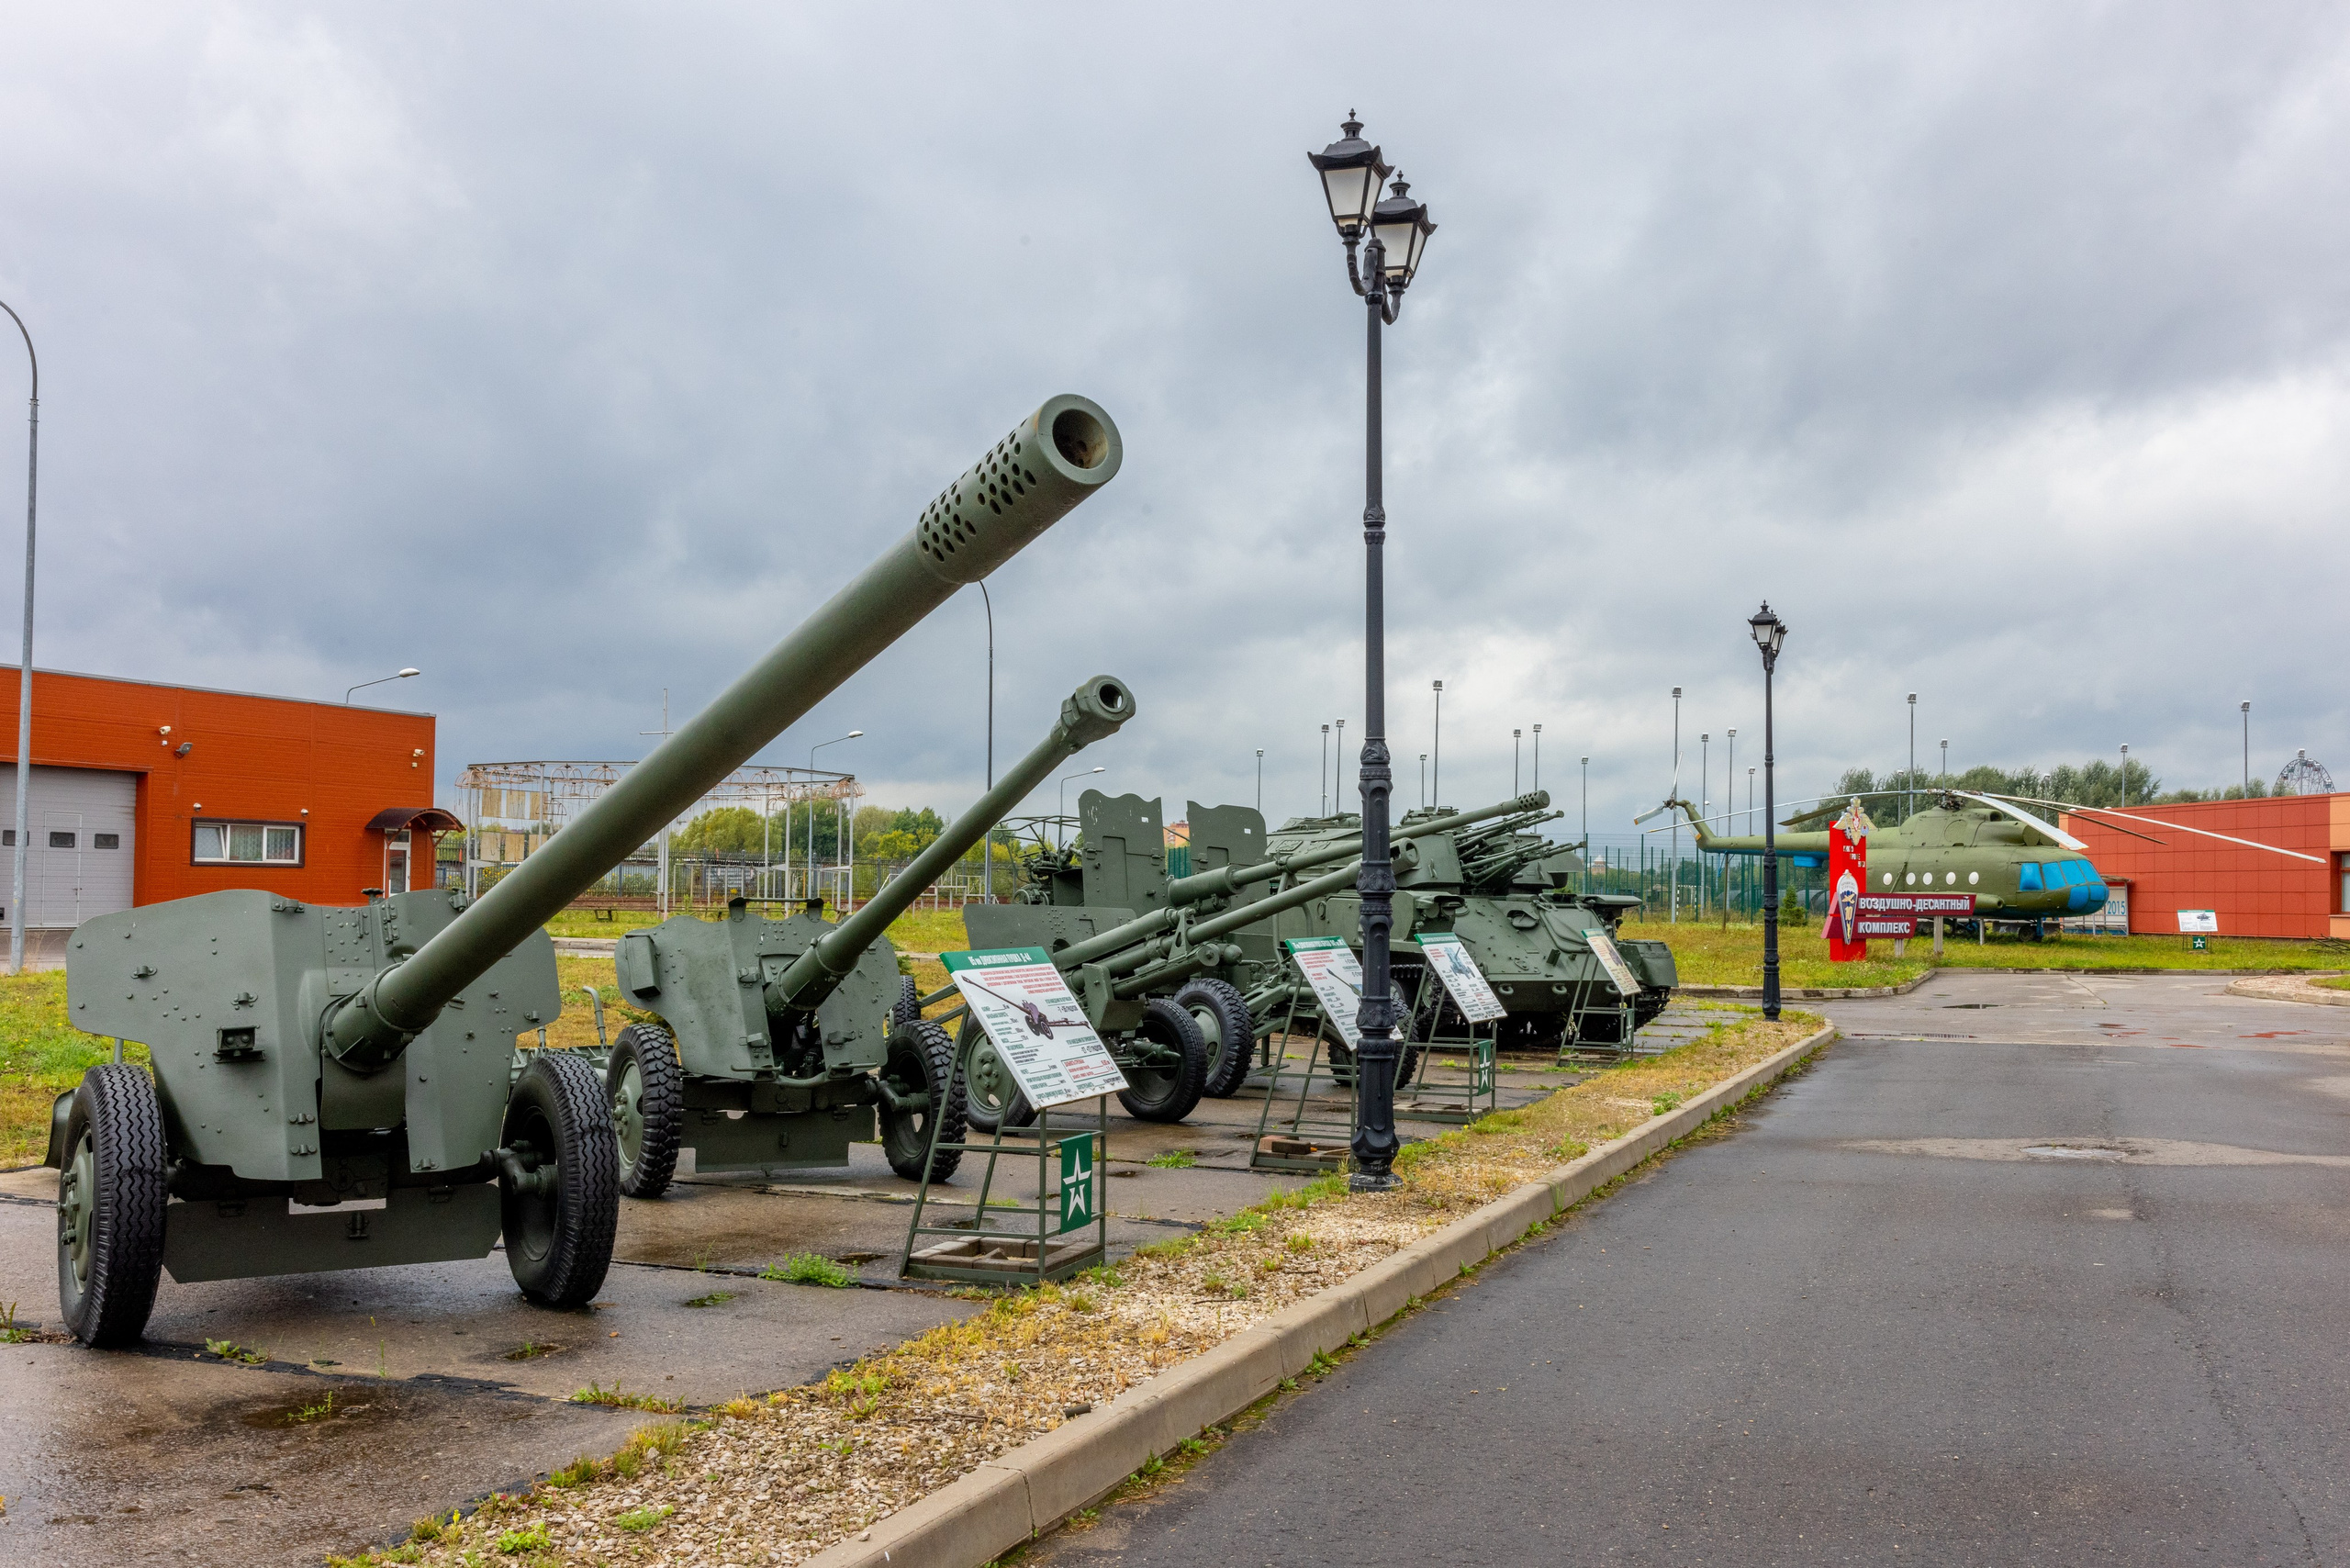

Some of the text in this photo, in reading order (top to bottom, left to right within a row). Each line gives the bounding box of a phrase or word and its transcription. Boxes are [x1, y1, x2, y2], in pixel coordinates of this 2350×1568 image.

[1859, 897, 1970, 912] ВОЗДУШНО-ДЕСАНТНЫЙ
[2107, 901, 2126, 915] 2015
[1858, 922, 1910, 934] КОМПЛЕКС
